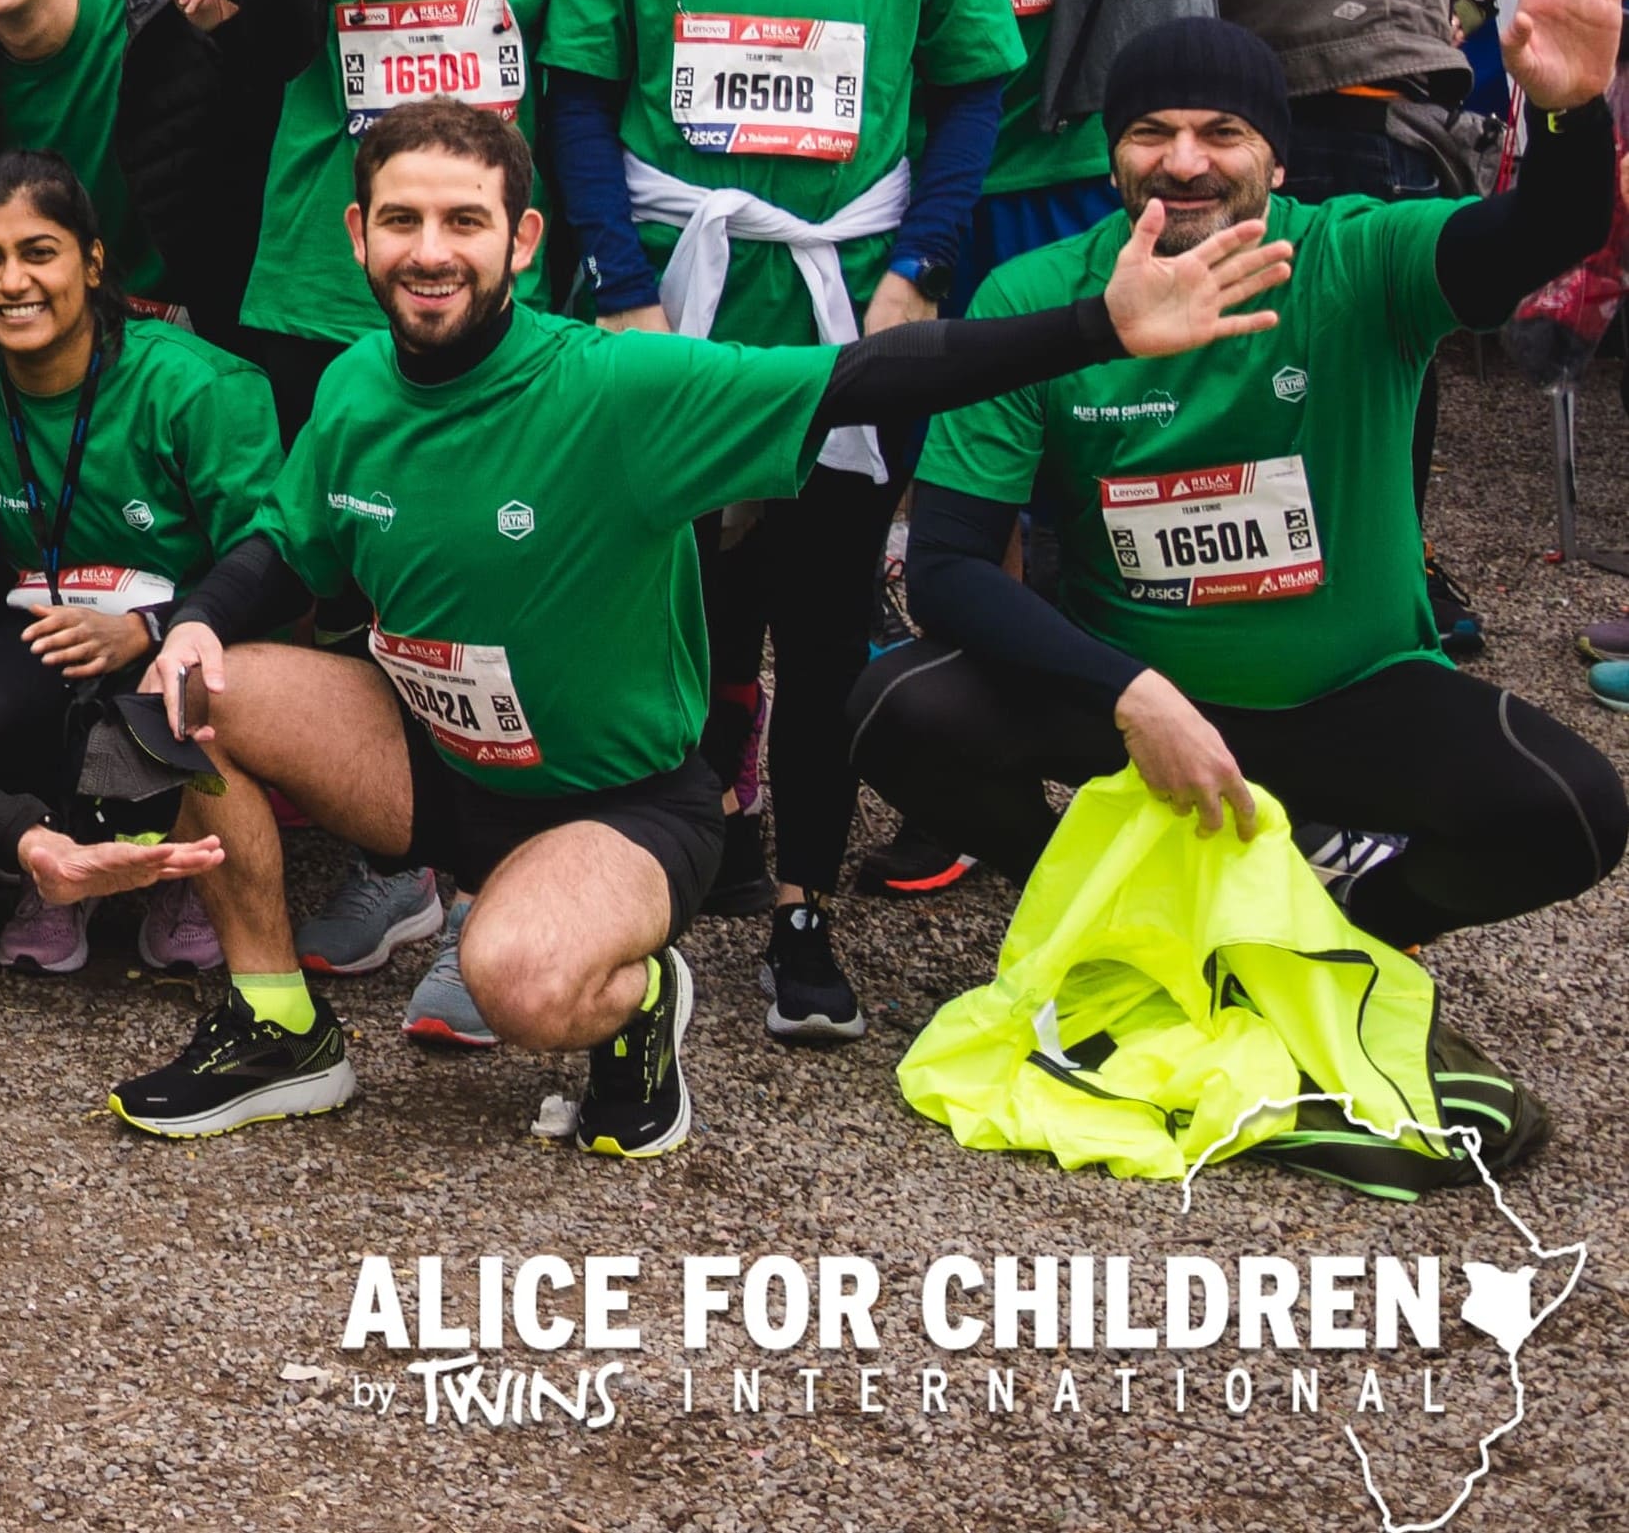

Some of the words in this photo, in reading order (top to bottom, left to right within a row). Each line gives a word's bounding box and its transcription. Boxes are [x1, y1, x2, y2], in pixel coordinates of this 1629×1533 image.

[419, 4, 457, 16] RELAY
[686, 24, 727, 35] Lenovo
[762, 23, 801, 36] RELAY
[380, 51, 482, 96] 1650D
[713, 70, 814, 114] 1650B
[817, 134, 854, 149] MILANO
[1072, 404, 1098, 418] ALICE
[1099, 405, 1120, 417] FOR
[1121, 401, 1167, 416] CHILDREN
[1190, 473, 1232, 486] RELAY
[1111, 485, 1155, 500] Lenovo
[1181, 505, 1201, 516] TEAM
[1153, 518, 1270, 568] 1650A
[82, 568, 114, 582] RELAY
[1146, 585, 1185, 601] asics
[1204, 582, 1248, 596] Telepass
[1277, 568, 1320, 585] MILANO
[409, 643, 443, 658] RELAY
[396, 674, 482, 732] 1642A
